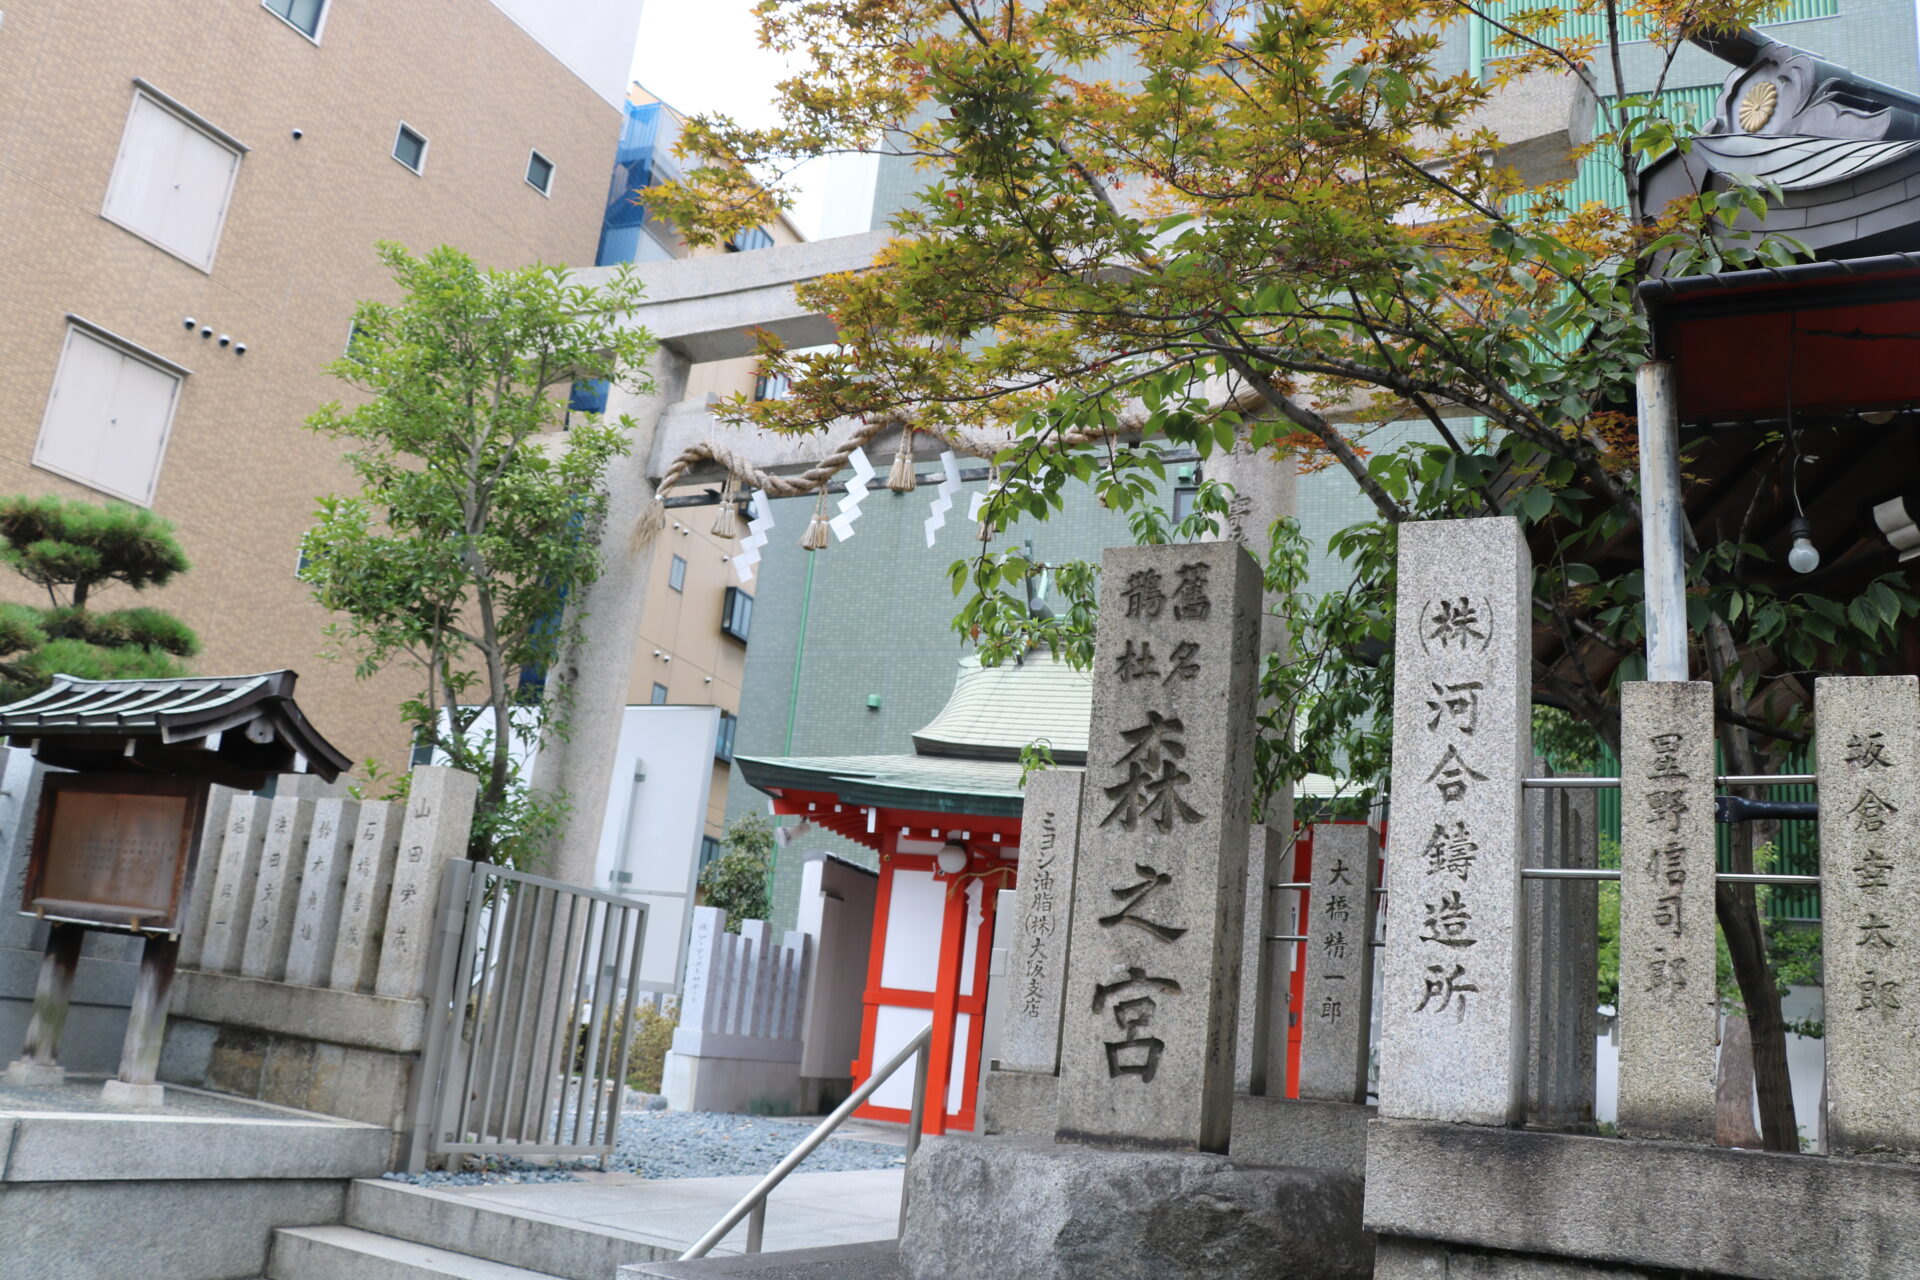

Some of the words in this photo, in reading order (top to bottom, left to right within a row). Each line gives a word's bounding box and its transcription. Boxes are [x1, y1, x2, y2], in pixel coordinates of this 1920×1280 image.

[1023, 812, 1056, 1017] ミヨシ油脂(株)大阪支店
[1092, 710, 1206, 1084] 森之宮
[1321, 859, 1352, 1024] 大橋精一郎
[1646, 733, 1690, 994] 星野信司郎
